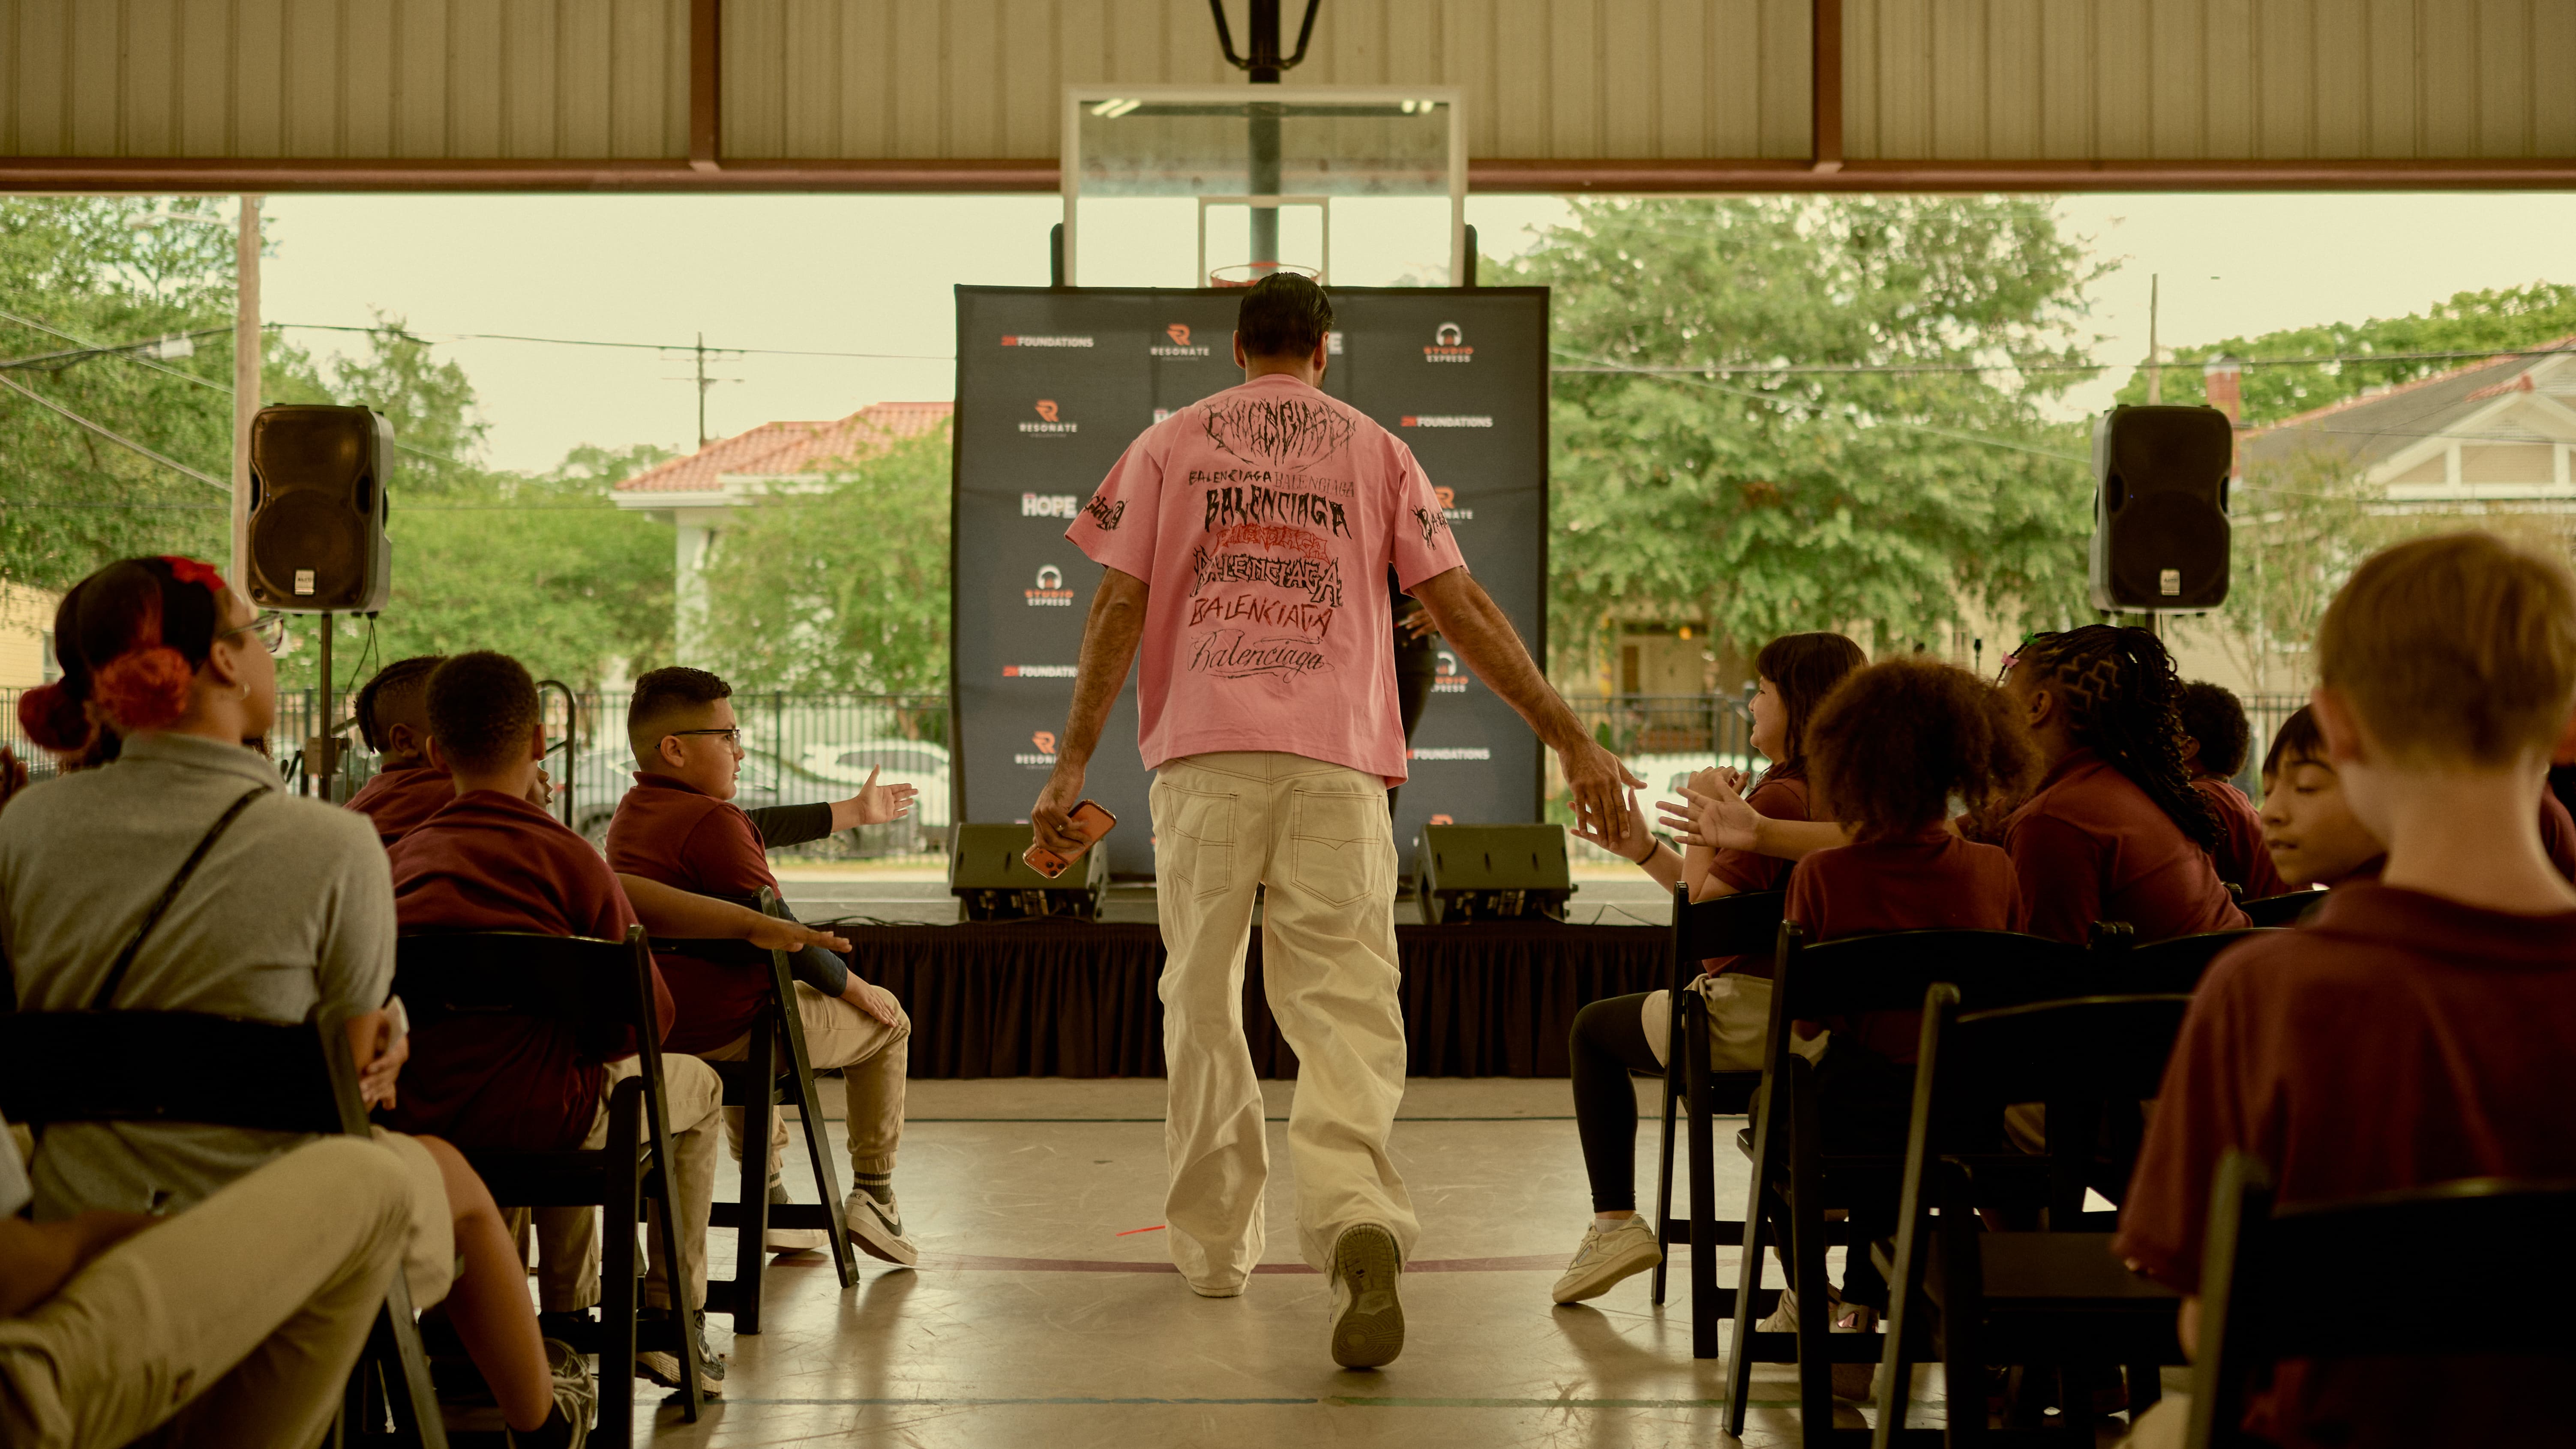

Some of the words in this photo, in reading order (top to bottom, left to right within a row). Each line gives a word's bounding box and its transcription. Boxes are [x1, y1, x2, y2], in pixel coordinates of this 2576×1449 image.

[1150, 347, 1210, 356] RESONATE
[1423, 345, 1474, 355] STUDIO
[1426, 354, 1471, 363] EXPRESS
[1018, 423, 1078, 433] RESONATE
[1188, 469, 1272, 486] BALENCIAGA
[1274, 471, 1355, 498] BALENCIAGA
[1022, 492, 1077, 519] HOPE
[1205, 484, 1352, 540] BALENCIAGA
[1442, 509, 1473, 520] NATE
[1189, 545, 1344, 607] BALENCIAGA
[1025, 589, 1074, 598] STUDIO
[1027, 597, 1071, 606] EXPRESS
[1188, 594, 1334, 637] BALENCIAGA
[1188, 628, 1335, 684] Balenciaga
[1435, 675, 1469, 685] UDIO
[1430, 683, 1466, 693] PRESS
[1014, 753, 1056, 765] RESON
